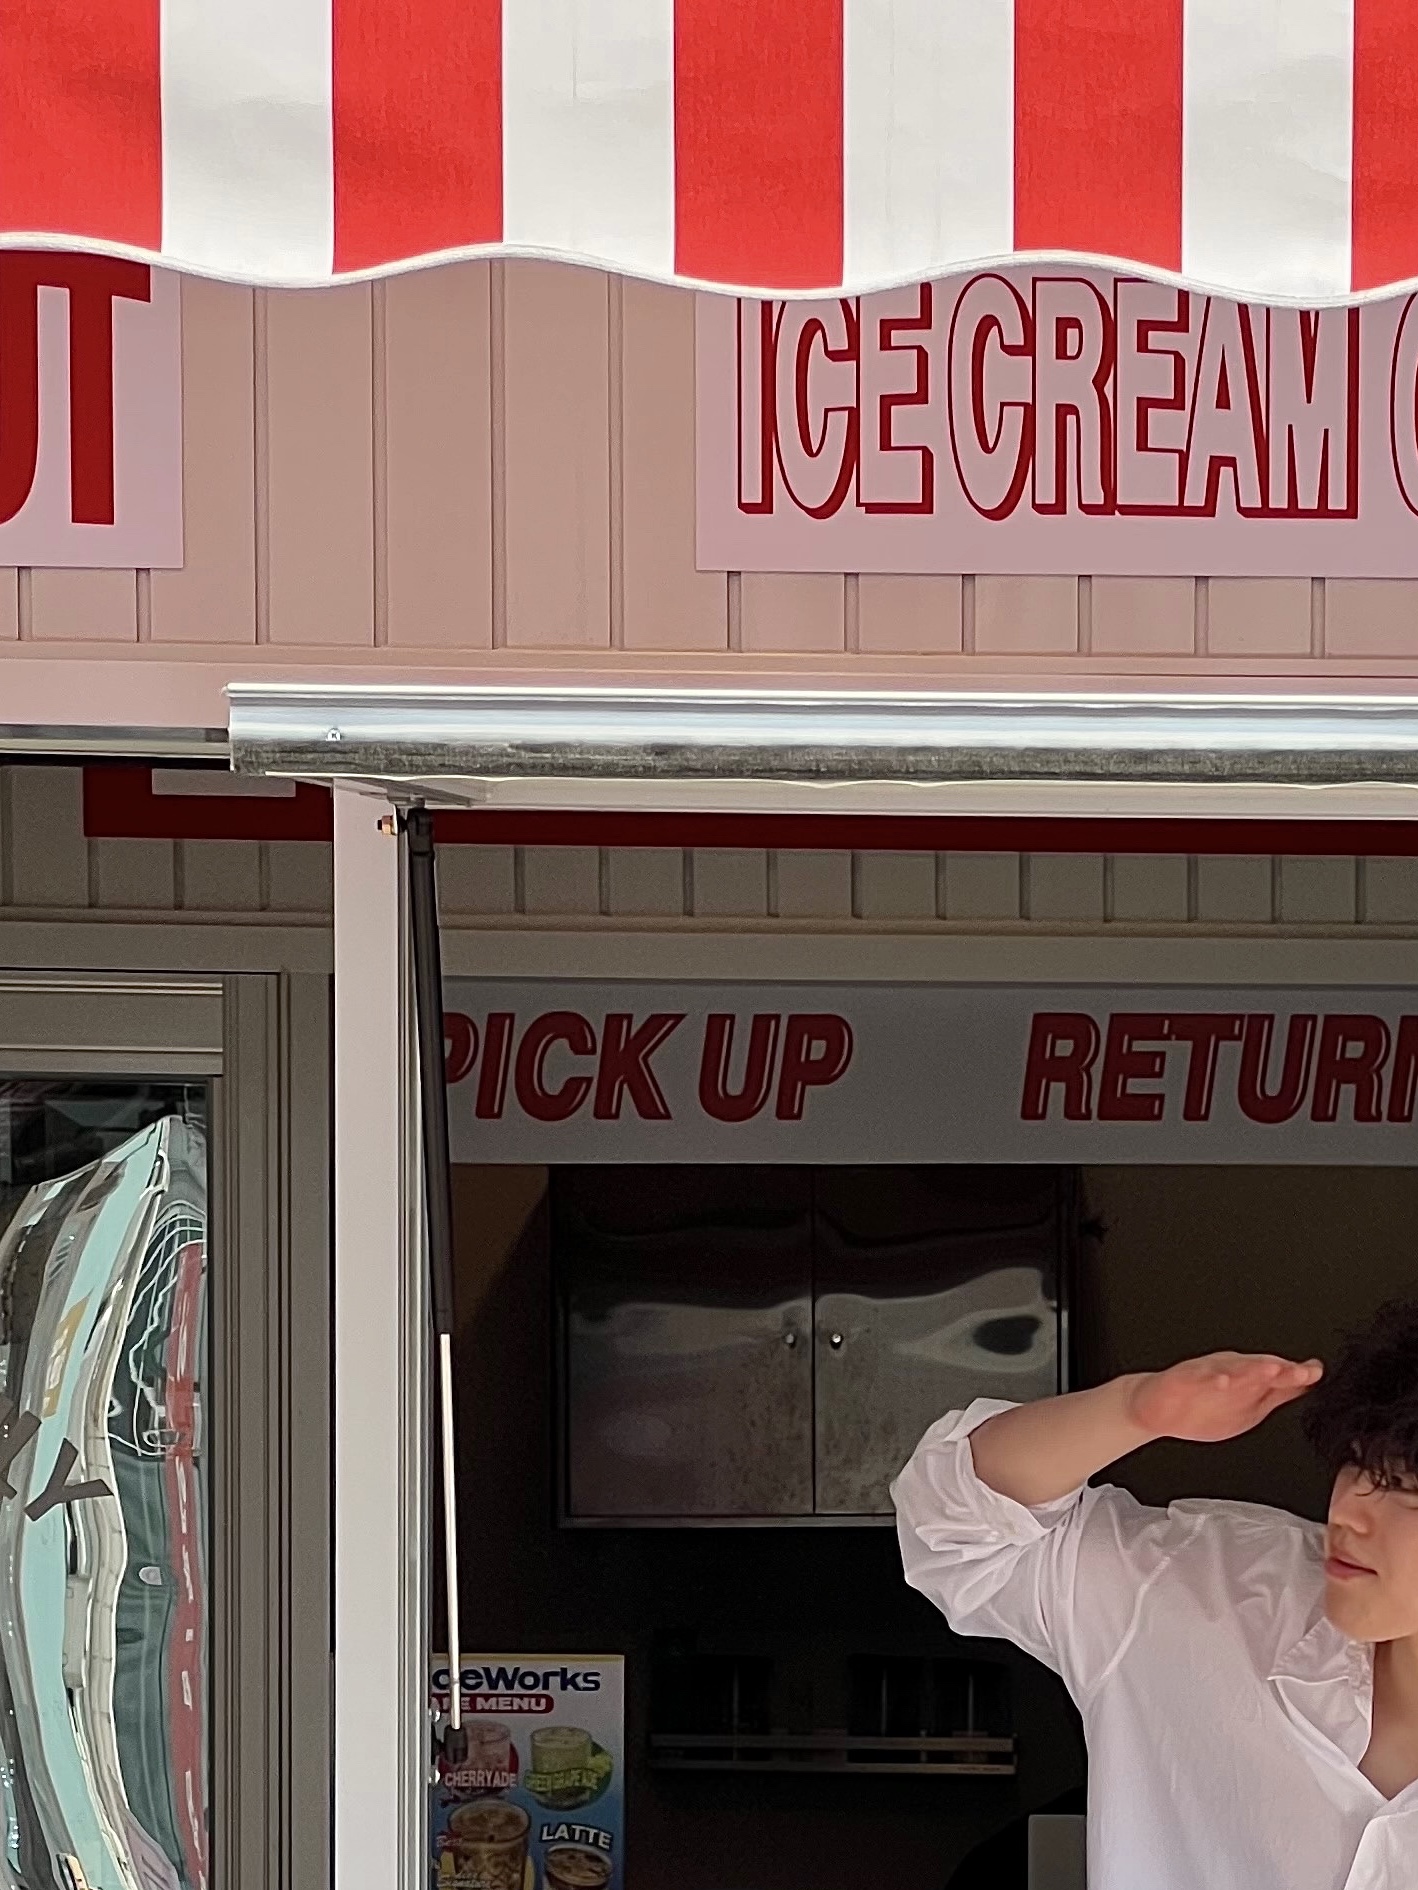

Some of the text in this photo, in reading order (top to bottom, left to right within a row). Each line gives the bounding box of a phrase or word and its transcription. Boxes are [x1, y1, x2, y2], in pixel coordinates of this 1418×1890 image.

[699, 1013, 853, 1122] UP
[475, 1697, 547, 1711] MENU
[541, 1823, 612, 1850] LATTE
